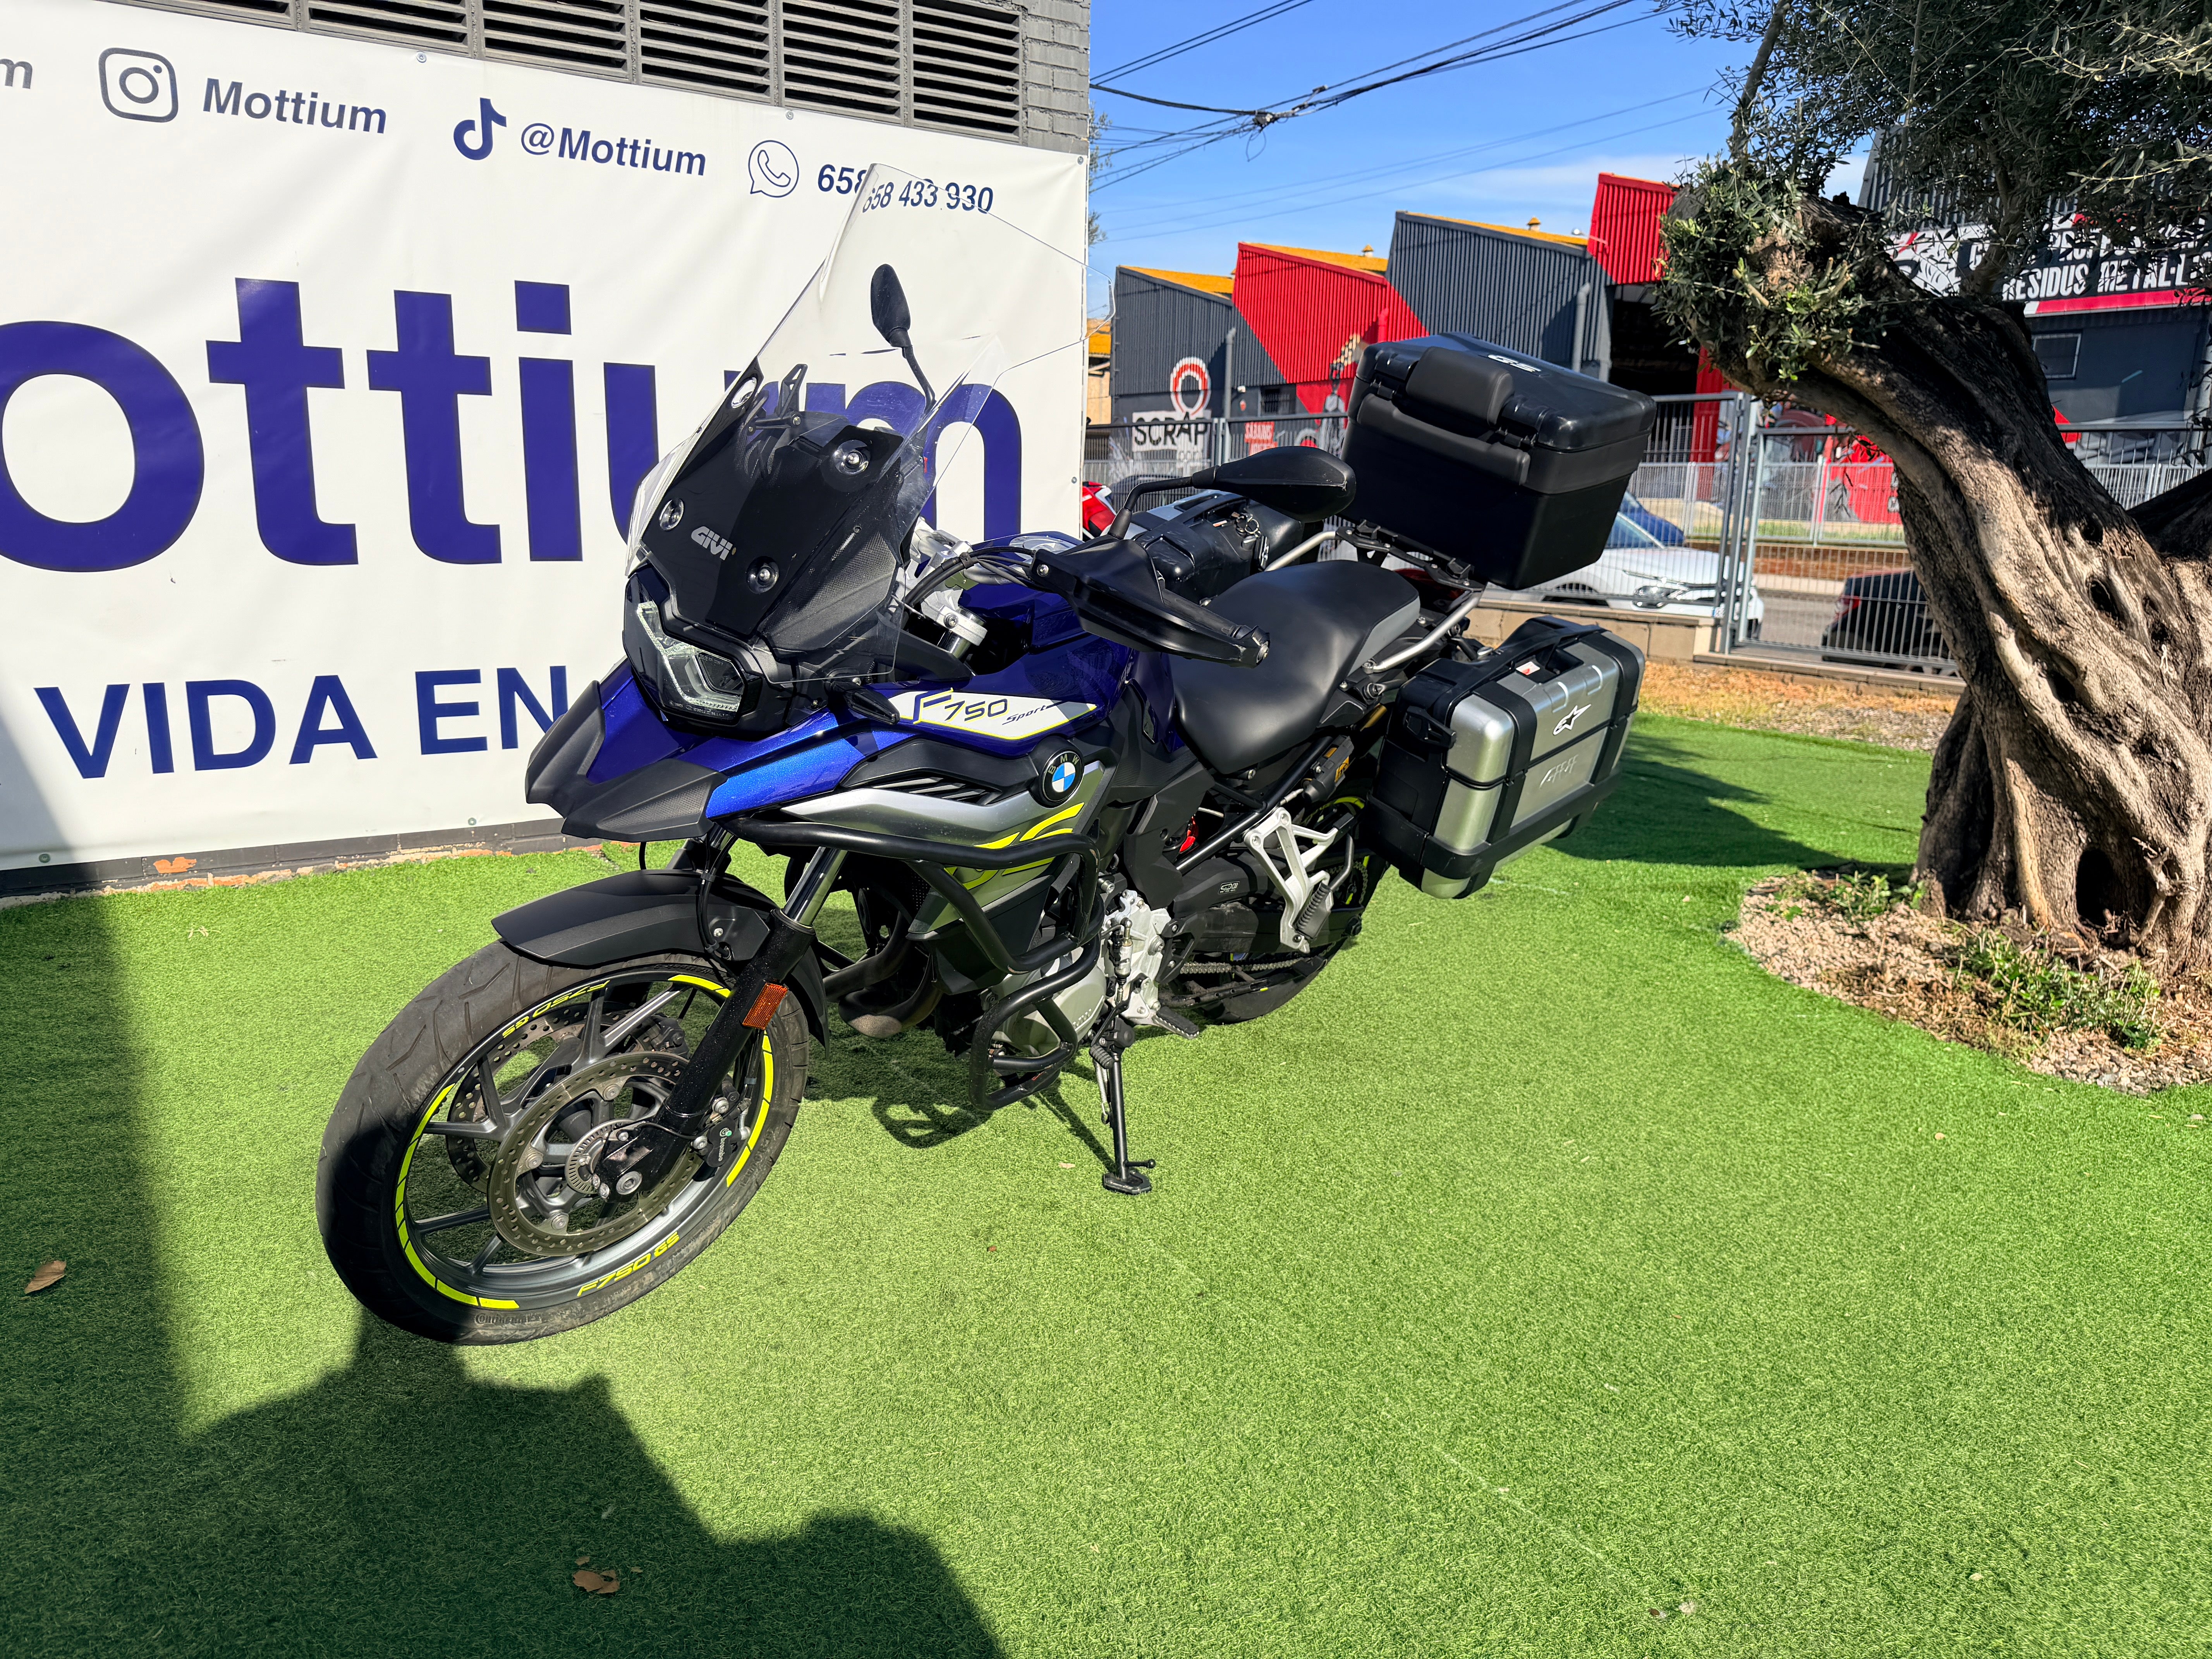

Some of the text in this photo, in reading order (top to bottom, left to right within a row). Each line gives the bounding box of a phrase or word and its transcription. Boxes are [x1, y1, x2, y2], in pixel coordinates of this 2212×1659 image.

[203, 78, 387, 134] Mottium
[521, 122, 706, 177] @Mottium
[898, 179, 938, 208] 433
[945, 182, 994, 214] 930
[2002, 263, 2089, 301] RESIDUS
[1487, 354, 1542, 373] GS
[1135, 412, 1208, 446] SCRAP
[691, 526, 733, 561] GIVI
[34, 665, 569, 779] VIDA EN
[1002, 703, 1052, 725] Sport
[1048, 754, 1080, 775] BMW
[502, 979, 610, 1039] F750 GS
[718, 1137, 727, 1162] brembo
[577, 1252, 652, 1297] F750
[654, 1231, 681, 1258] GS
